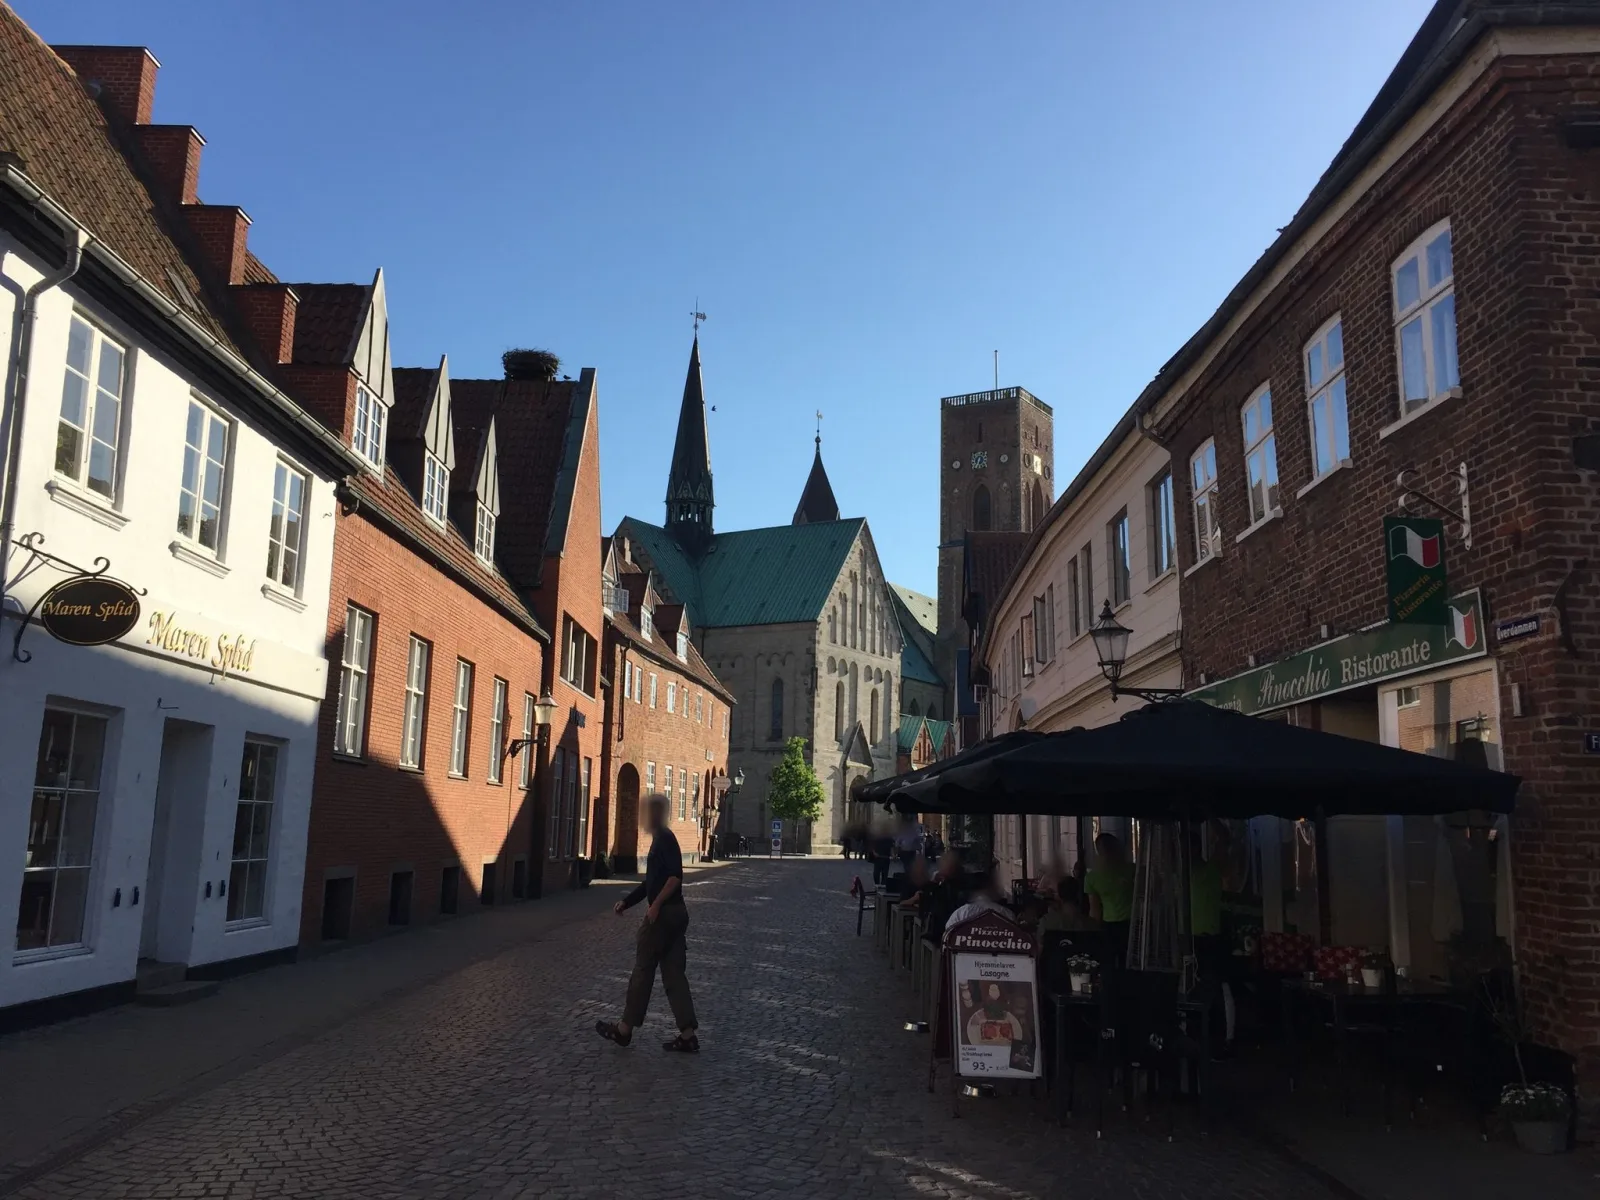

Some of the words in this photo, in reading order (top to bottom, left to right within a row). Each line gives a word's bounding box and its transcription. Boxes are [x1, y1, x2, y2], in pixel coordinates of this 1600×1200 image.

[1392, 573, 1431, 606] Pizzeria
[1396, 579, 1444, 621] Ristorante
[43, 600, 91, 616] Maren
[95, 600, 137, 621] Splid
[1496, 620, 1538, 640] Overdammen
[146, 611, 210, 660] Maren
[211, 633, 257, 681] Splid
[1257, 654, 1331, 708] Pinocchio
[1340, 638, 1431, 684] Ristorante
[970, 927, 1014, 937] Pizzeria
[955, 935, 1032, 950] Pinocchio
[974, 961, 1015, 969] Hjemmelavet
[980, 969, 1010, 979] Lasagne
[972, 1061, 993, 1072] 93,-
